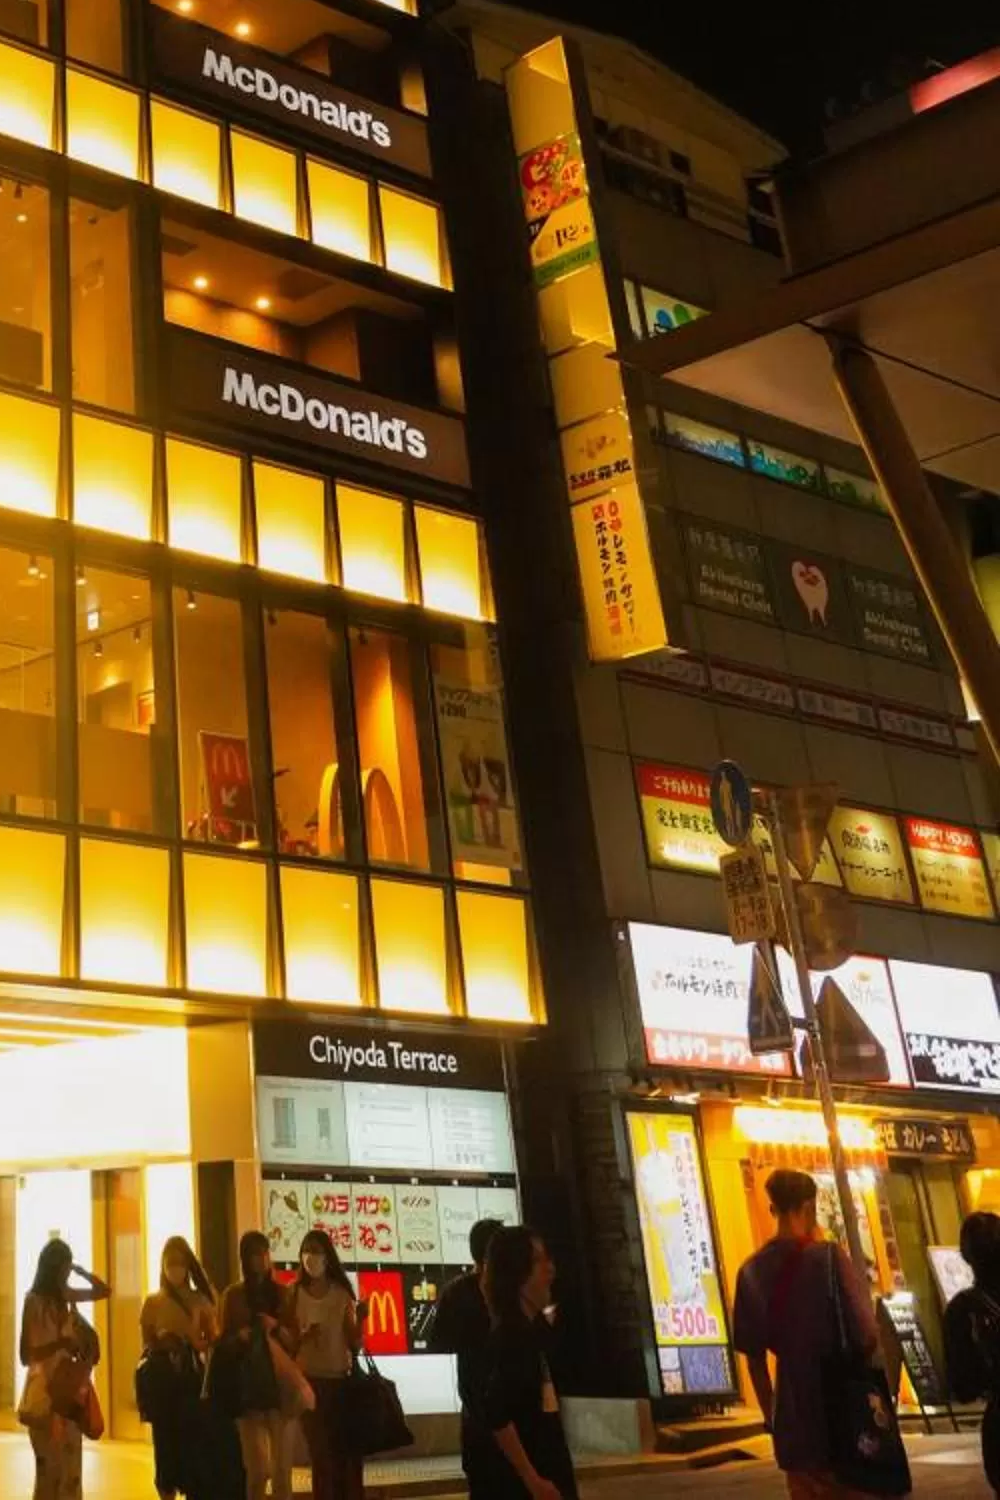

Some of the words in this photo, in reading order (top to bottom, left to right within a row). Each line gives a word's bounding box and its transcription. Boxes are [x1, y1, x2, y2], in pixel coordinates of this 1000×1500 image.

[202, 48, 391, 148] McDonald's
[222, 367, 428, 459] McDonald's
[309, 1035, 387, 1073] Chiyoda
[388, 1041, 459, 1074] Terrace
[323, 1194, 381, 1215] カラオケ
